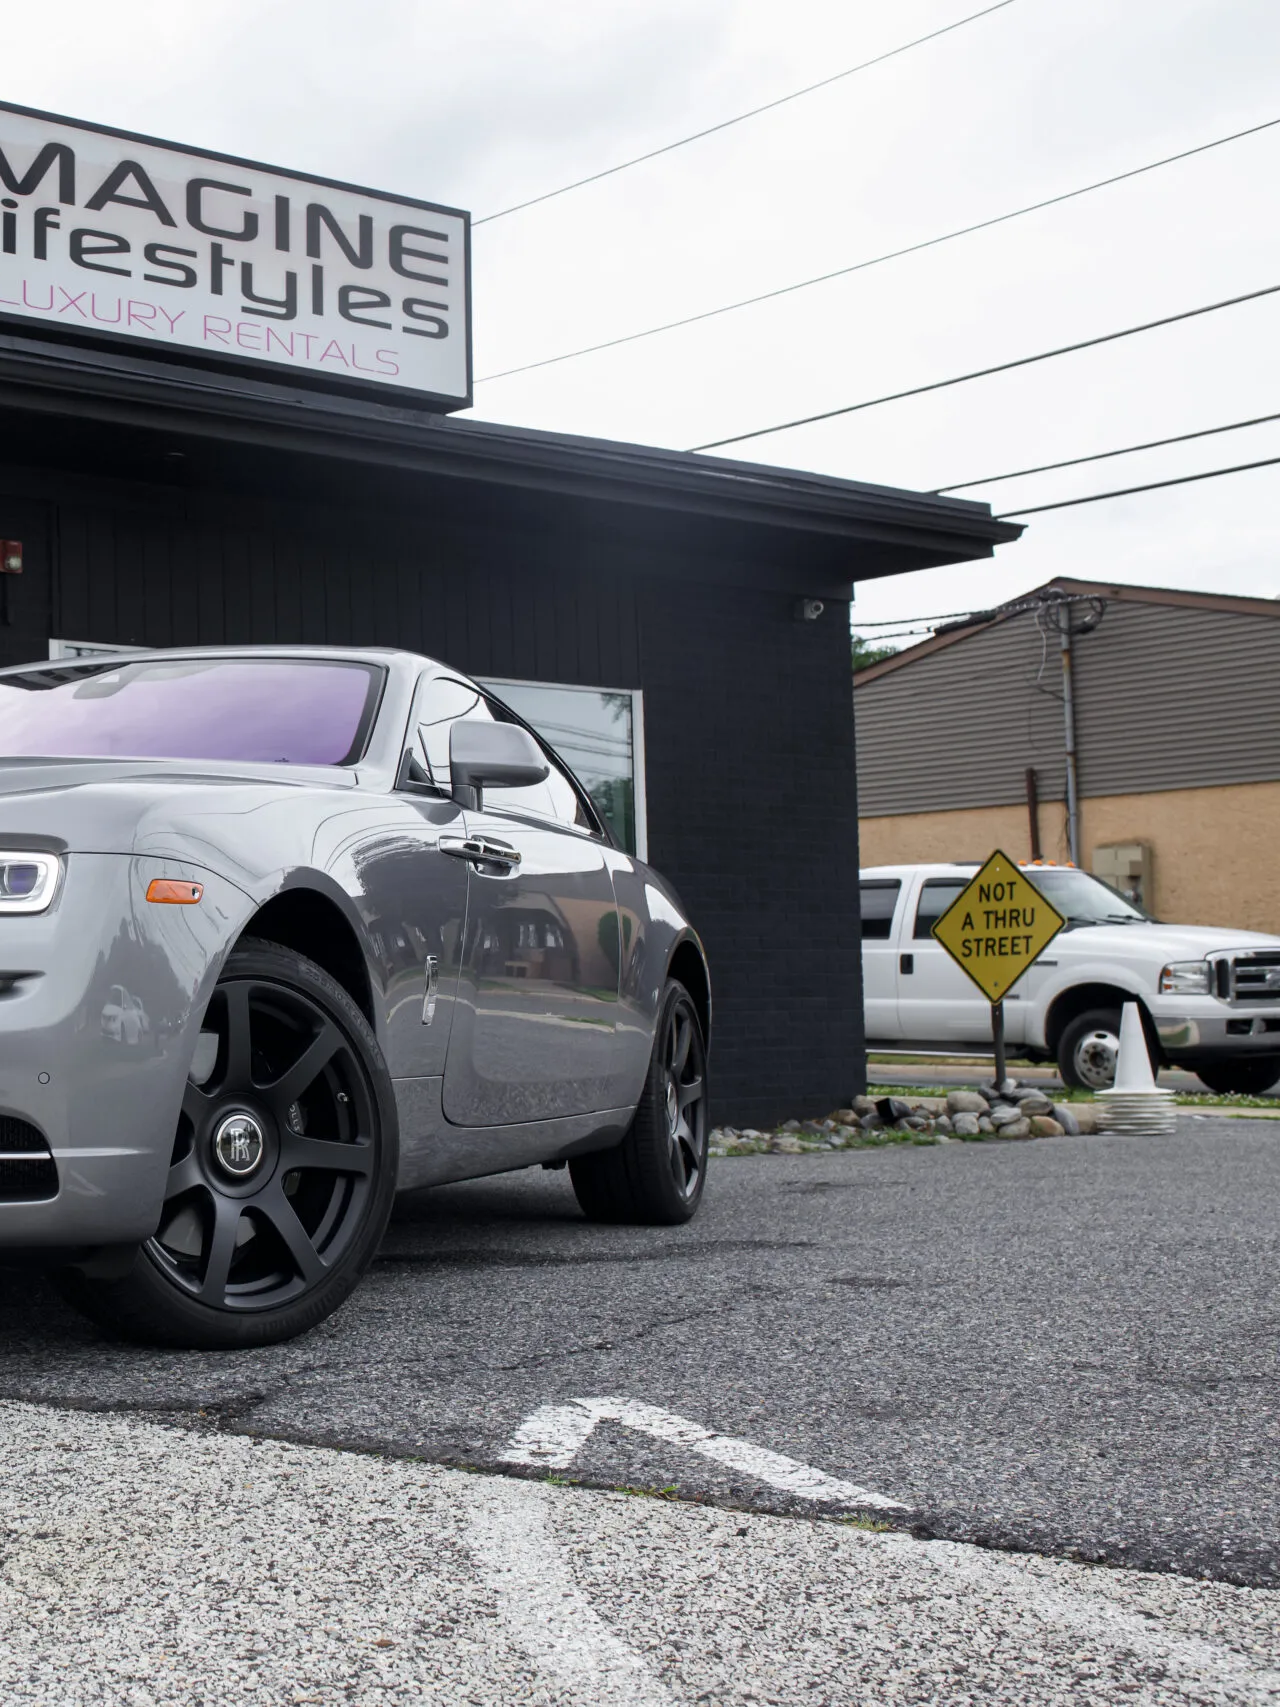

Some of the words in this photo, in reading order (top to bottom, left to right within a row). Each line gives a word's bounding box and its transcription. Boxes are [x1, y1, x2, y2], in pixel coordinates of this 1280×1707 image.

[203, 314, 400, 376] RENTALS
[978, 882, 1017, 903] NOT
[961, 912, 975, 931] A
[983, 907, 1035, 930] THRU
[961, 935, 1033, 958] STREET
